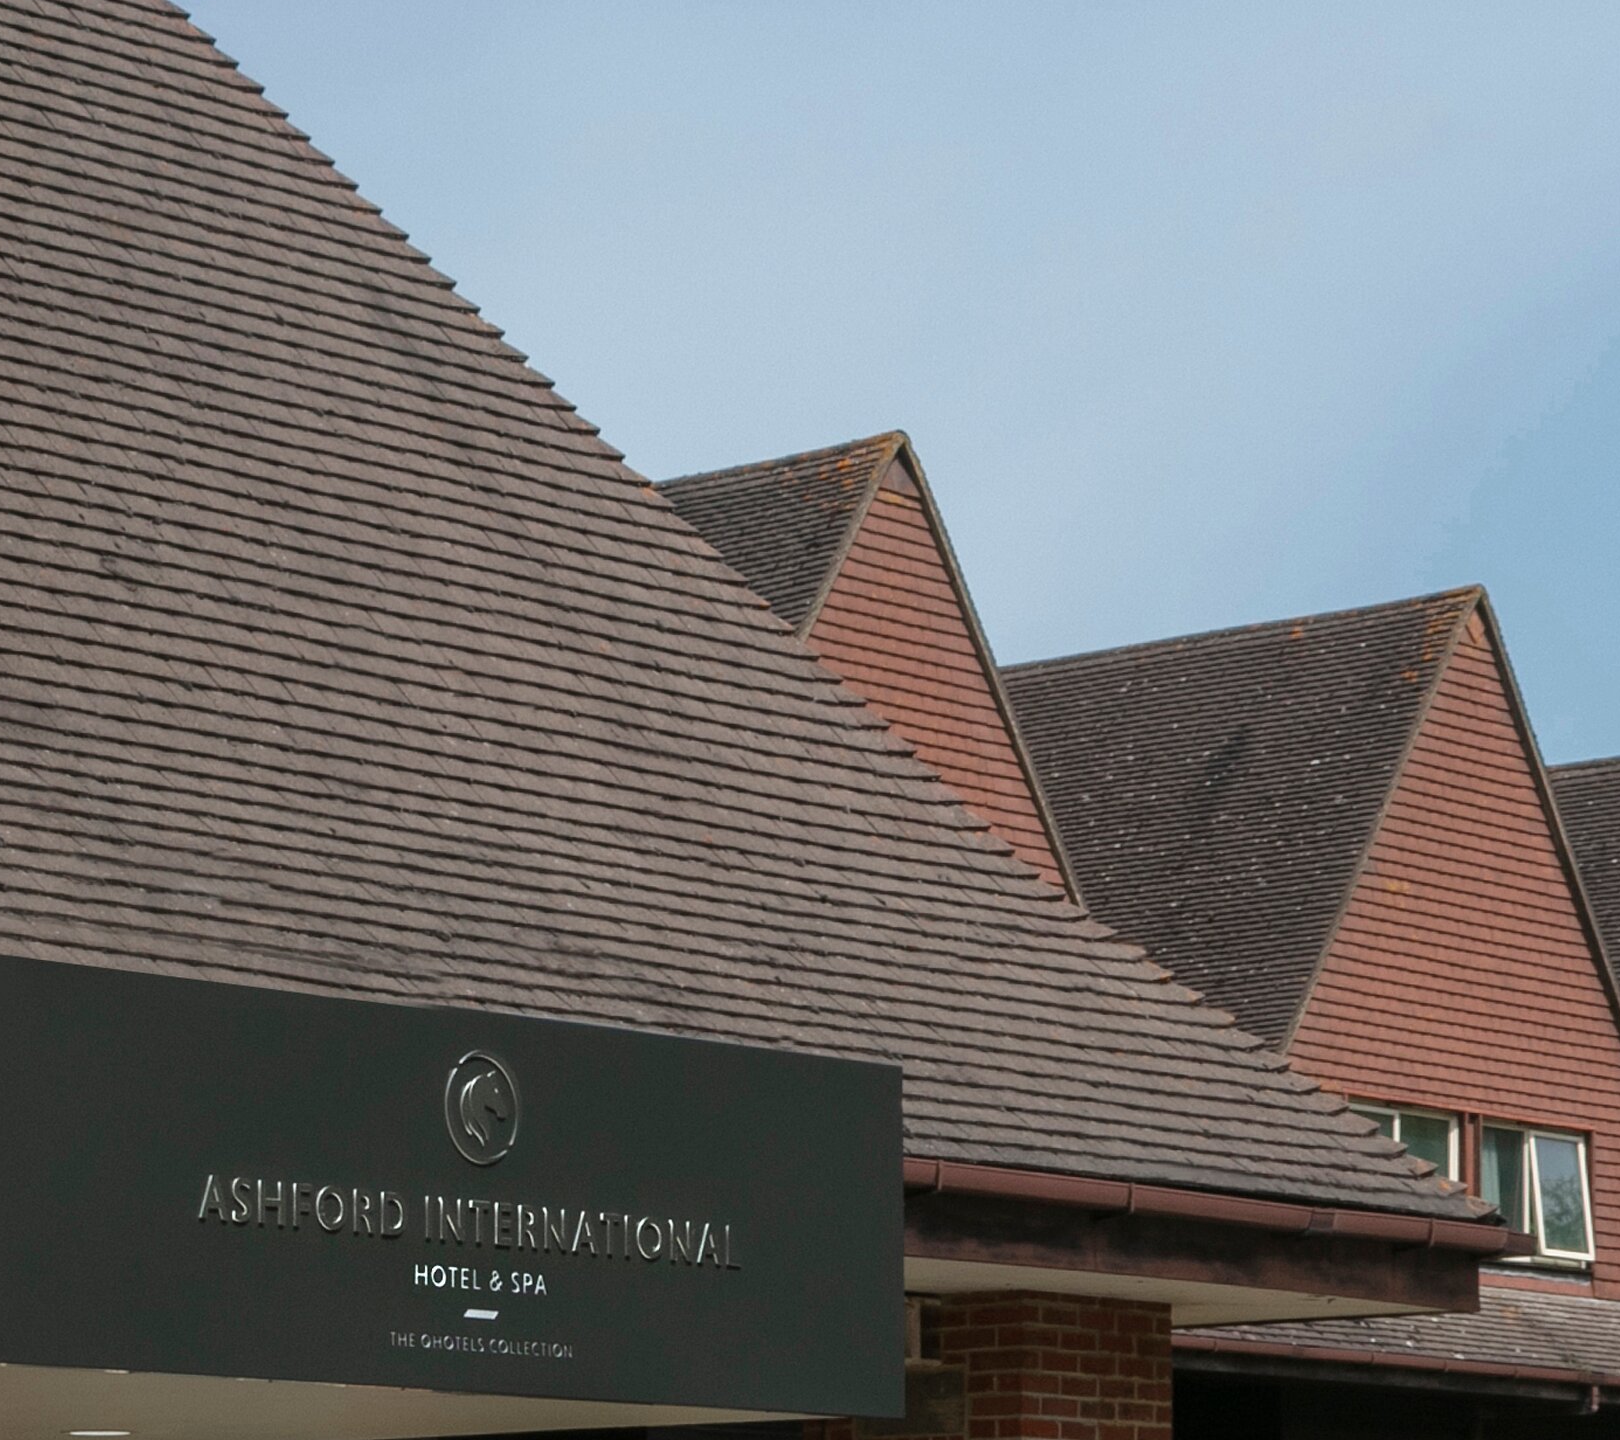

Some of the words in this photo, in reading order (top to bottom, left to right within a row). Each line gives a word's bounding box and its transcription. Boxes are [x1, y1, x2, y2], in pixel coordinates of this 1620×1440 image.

[197, 1174, 406, 1238] ASHFORD
[424, 1194, 742, 1270] INTERNATIONAL
[414, 1264, 482, 1290] HOTEL
[489, 1270, 503, 1292] &
[511, 1271, 547, 1295] SPA
[390, 1331, 416, 1348] THE
[489, 1338, 573, 1358] COLLECTION
